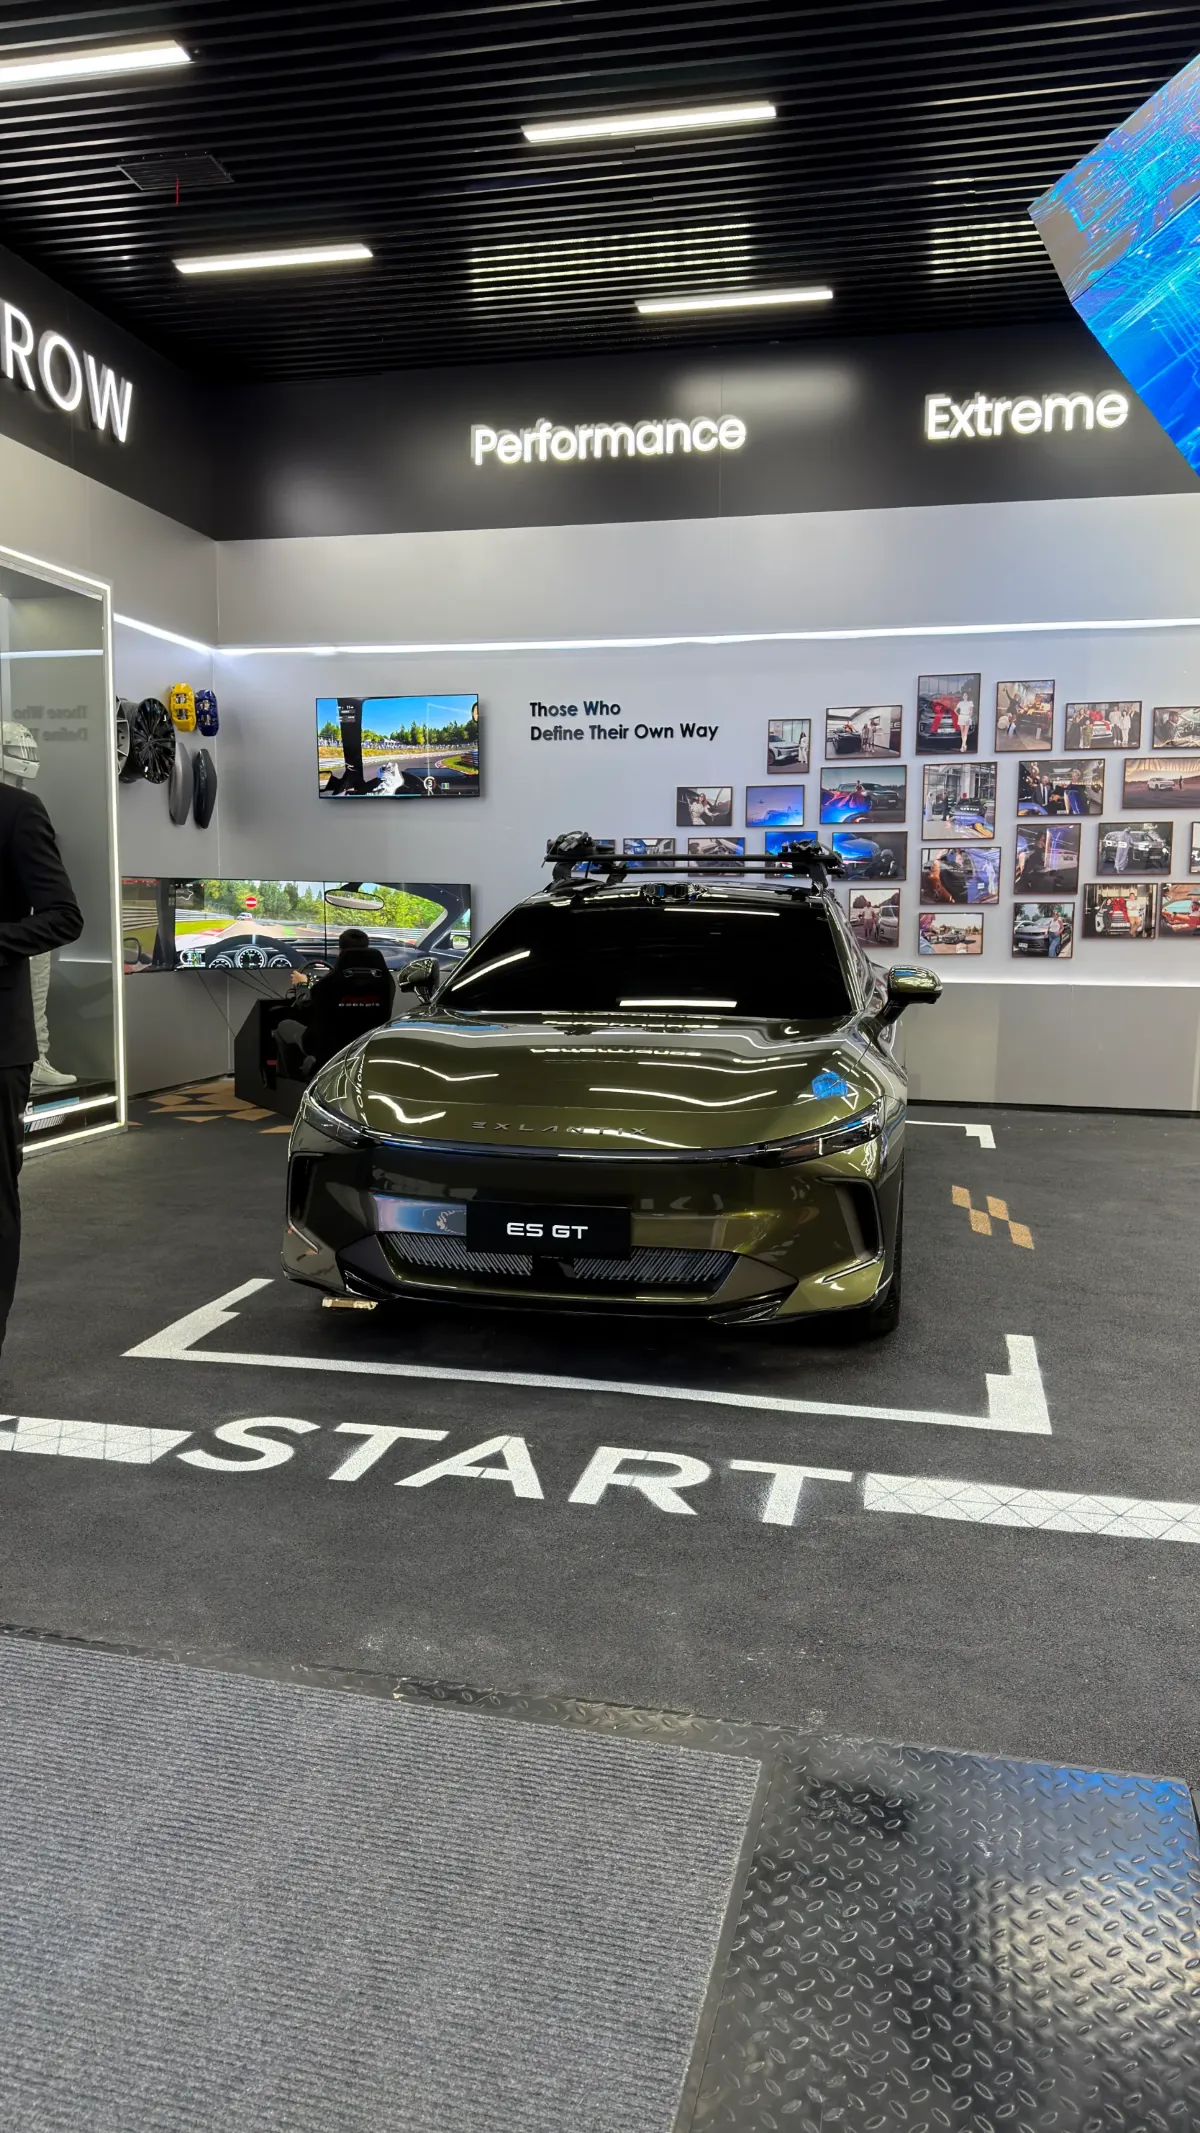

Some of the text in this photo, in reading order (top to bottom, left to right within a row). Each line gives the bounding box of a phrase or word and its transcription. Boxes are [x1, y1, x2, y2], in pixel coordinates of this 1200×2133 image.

[0, 299, 133, 443] ROW
[926, 391, 1129, 440] Extreme
[472, 418, 746, 465] Performance
[529, 700, 621, 717] Those Who
[530, 722, 719, 741] Define Their Own Way
[506, 1222, 588, 1239] ES GT
[176, 1416, 852, 1526] START
